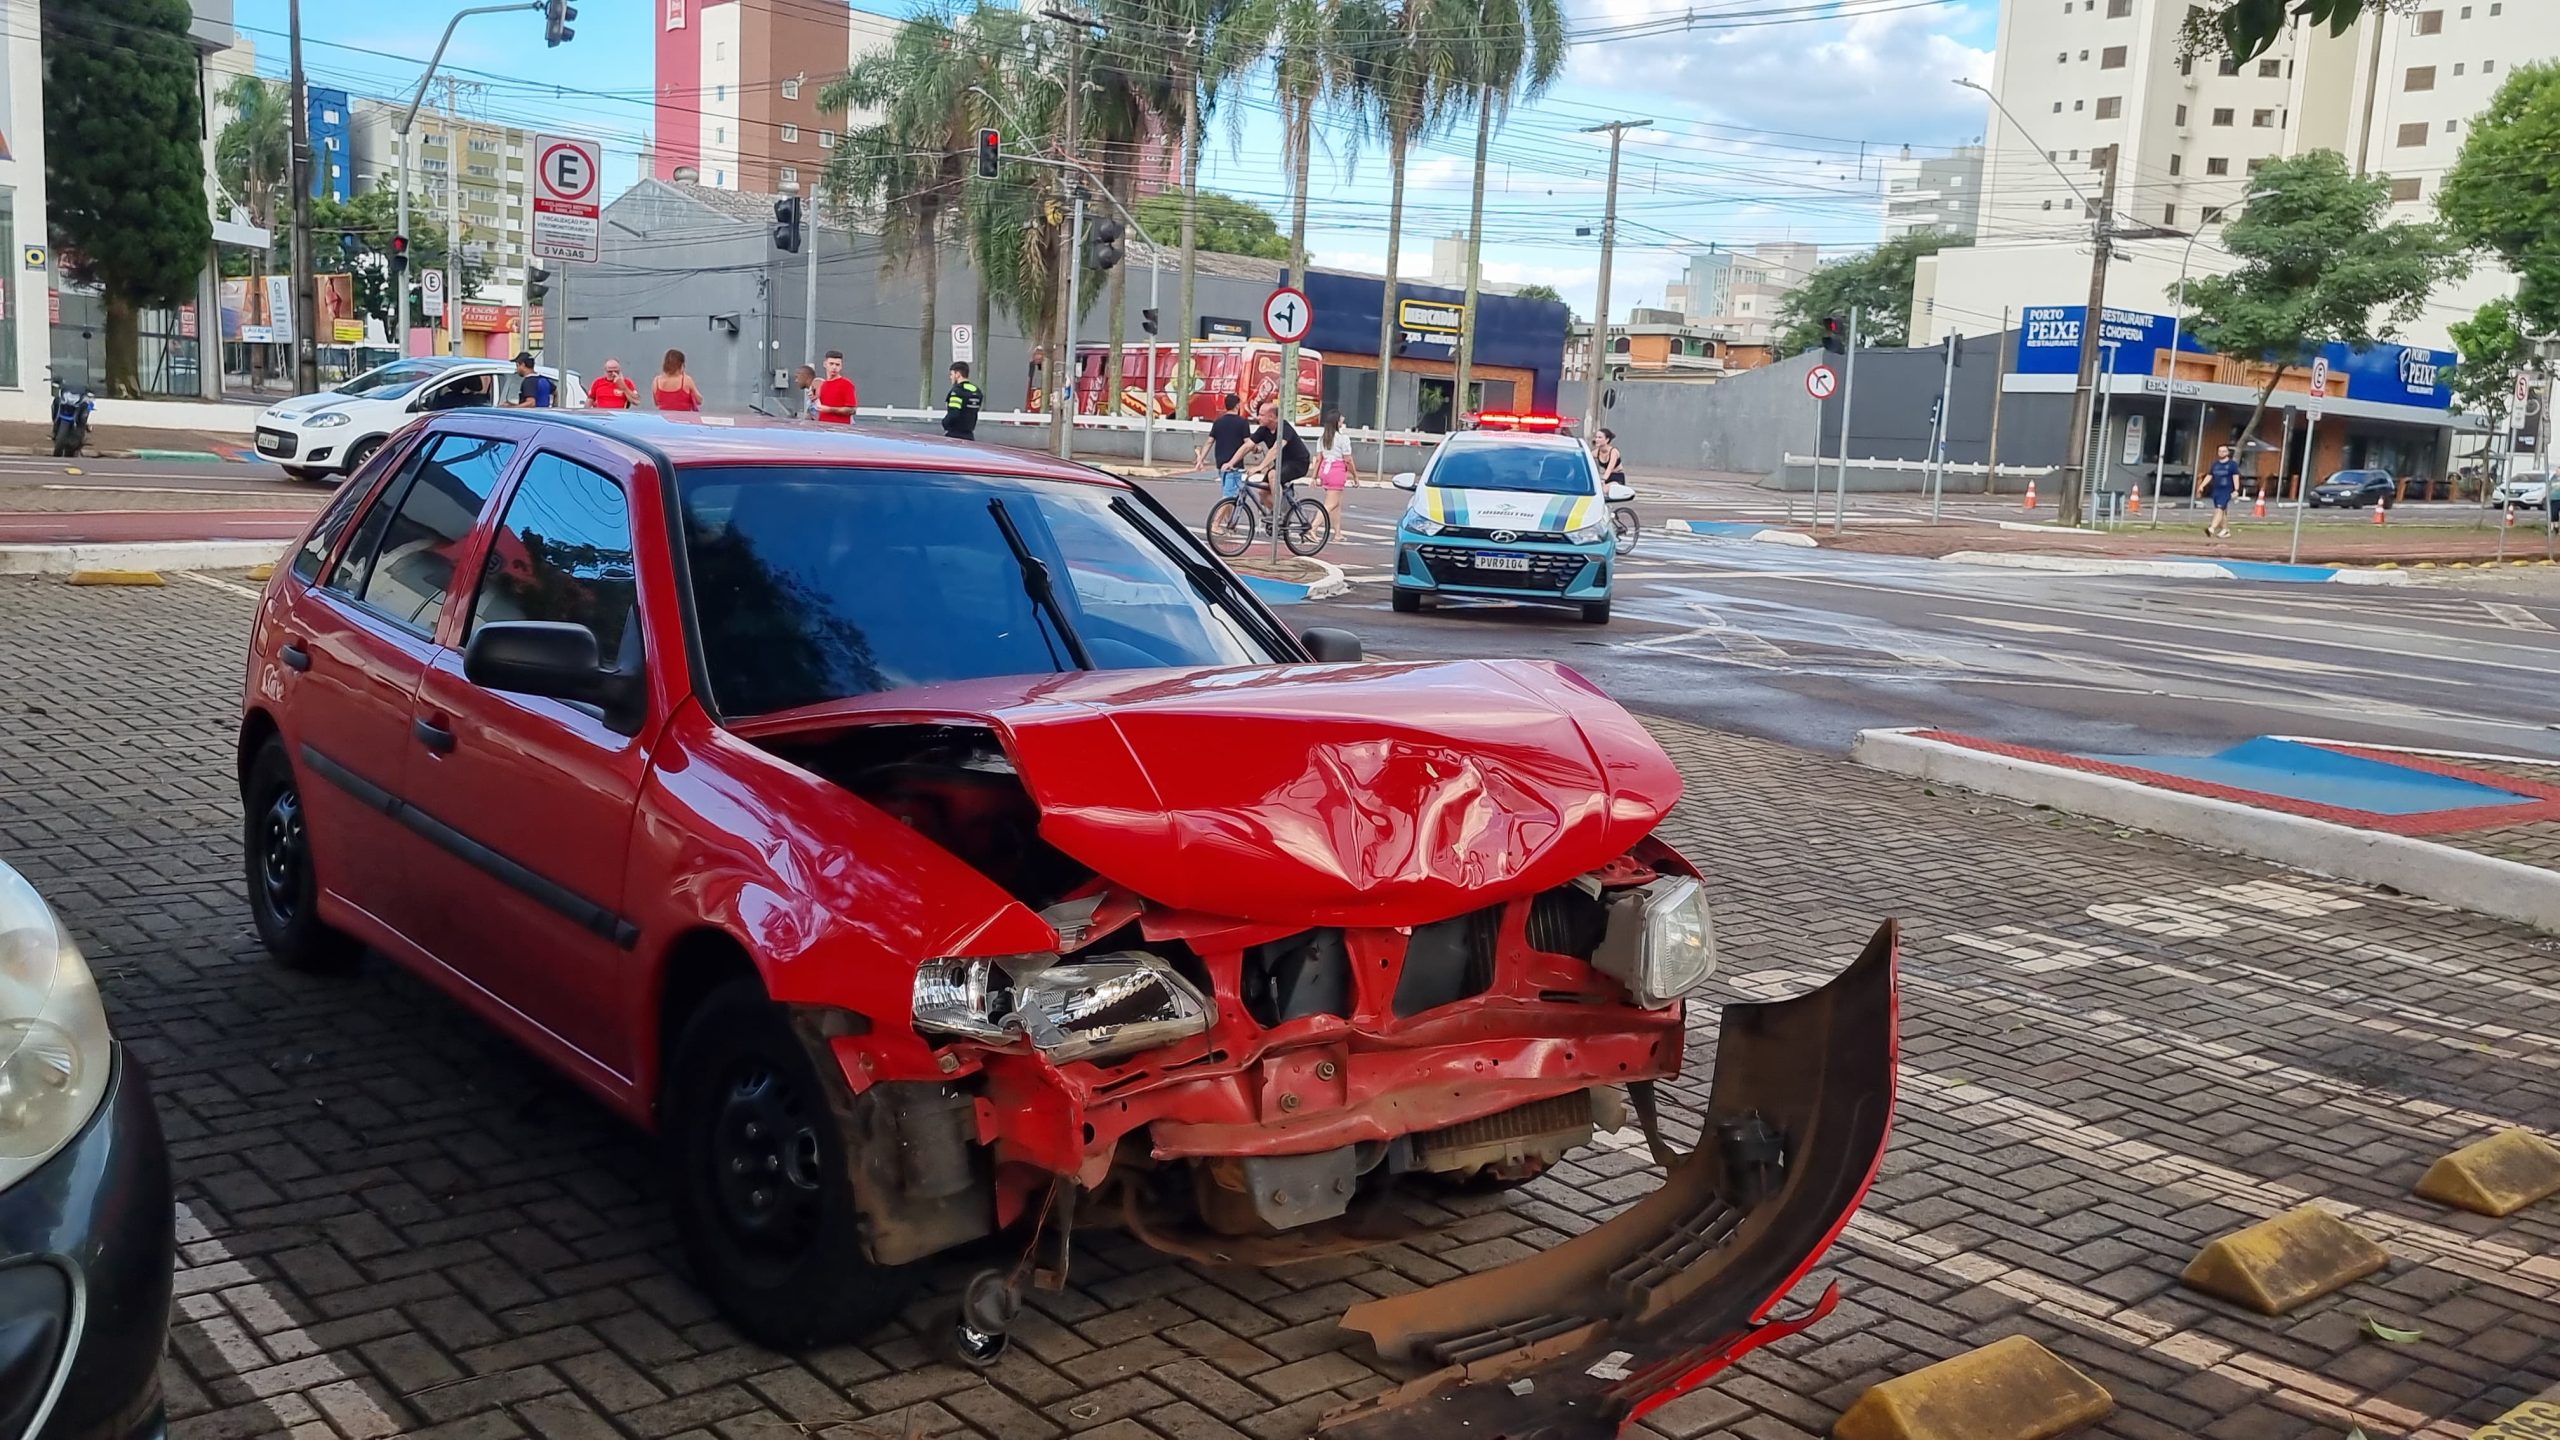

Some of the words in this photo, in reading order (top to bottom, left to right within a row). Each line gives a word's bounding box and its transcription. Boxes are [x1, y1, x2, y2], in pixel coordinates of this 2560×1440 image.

[558, 154, 578, 189] E
[542, 215, 579, 225] FISCALIZAÇÃO
[429, 276, 436, 288] E
[2029, 309, 2065, 321] PORTO
[2101, 308, 2154, 328] RESTAURANTE
[959, 330, 966, 340] E
[2027, 321, 2080, 340] PEIXE
[2099, 323, 2105, 337] E
[2106, 325, 2144, 342] CHOPERIA
[2026, 339, 2079, 348] RESTAURANTE
[2411, 348, 2430, 362] PORTO
[2408, 362, 2437, 386] PEIXE
